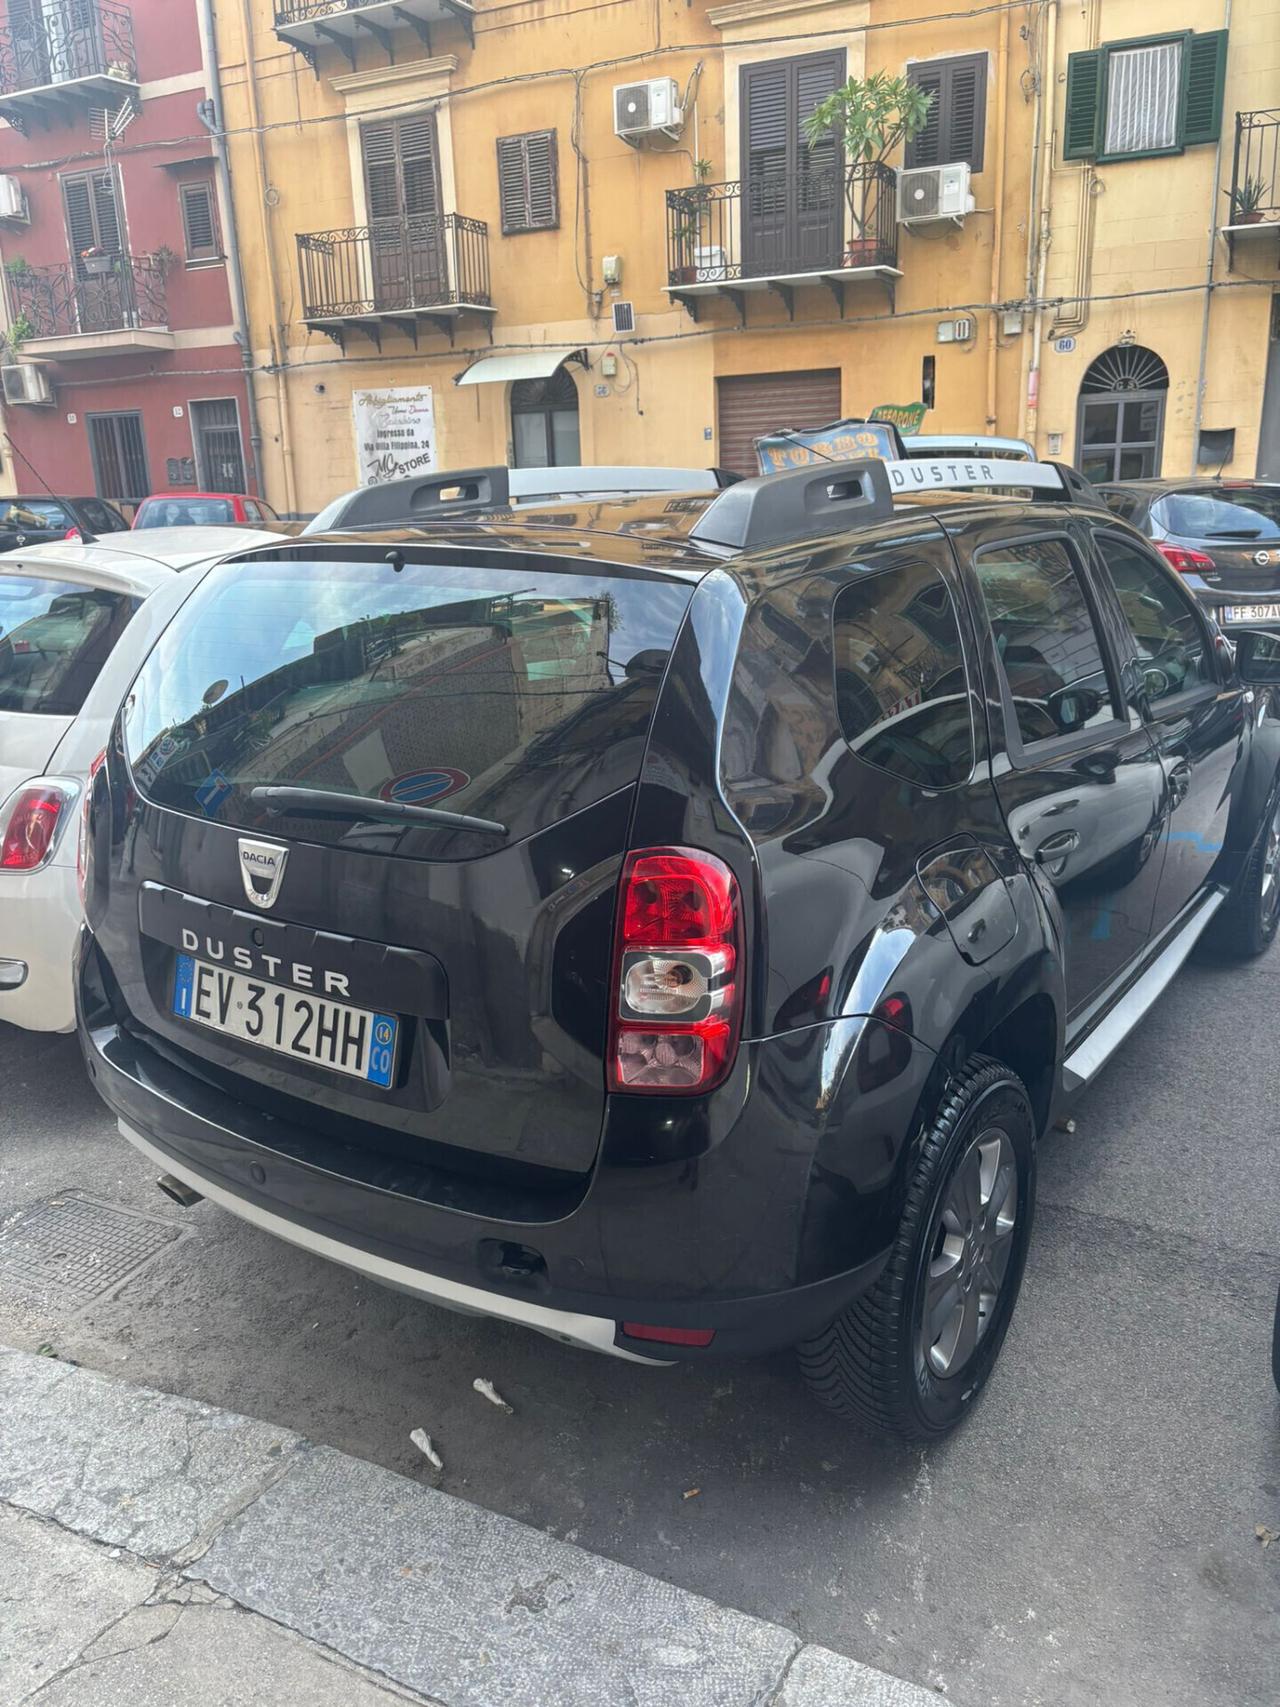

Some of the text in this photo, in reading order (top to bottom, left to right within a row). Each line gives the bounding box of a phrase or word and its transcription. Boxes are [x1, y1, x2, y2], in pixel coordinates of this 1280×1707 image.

[1058, 339, 1072, 350] 60
[376, 428, 405, 439] Ingresso
[397, 452, 431, 474] STORE
[891, 464, 995, 487] DUSTER
[242, 850, 276, 867] DACIA
[181, 927, 351, 997] DUSTER
[370, 1049, 390, 1073] CO
